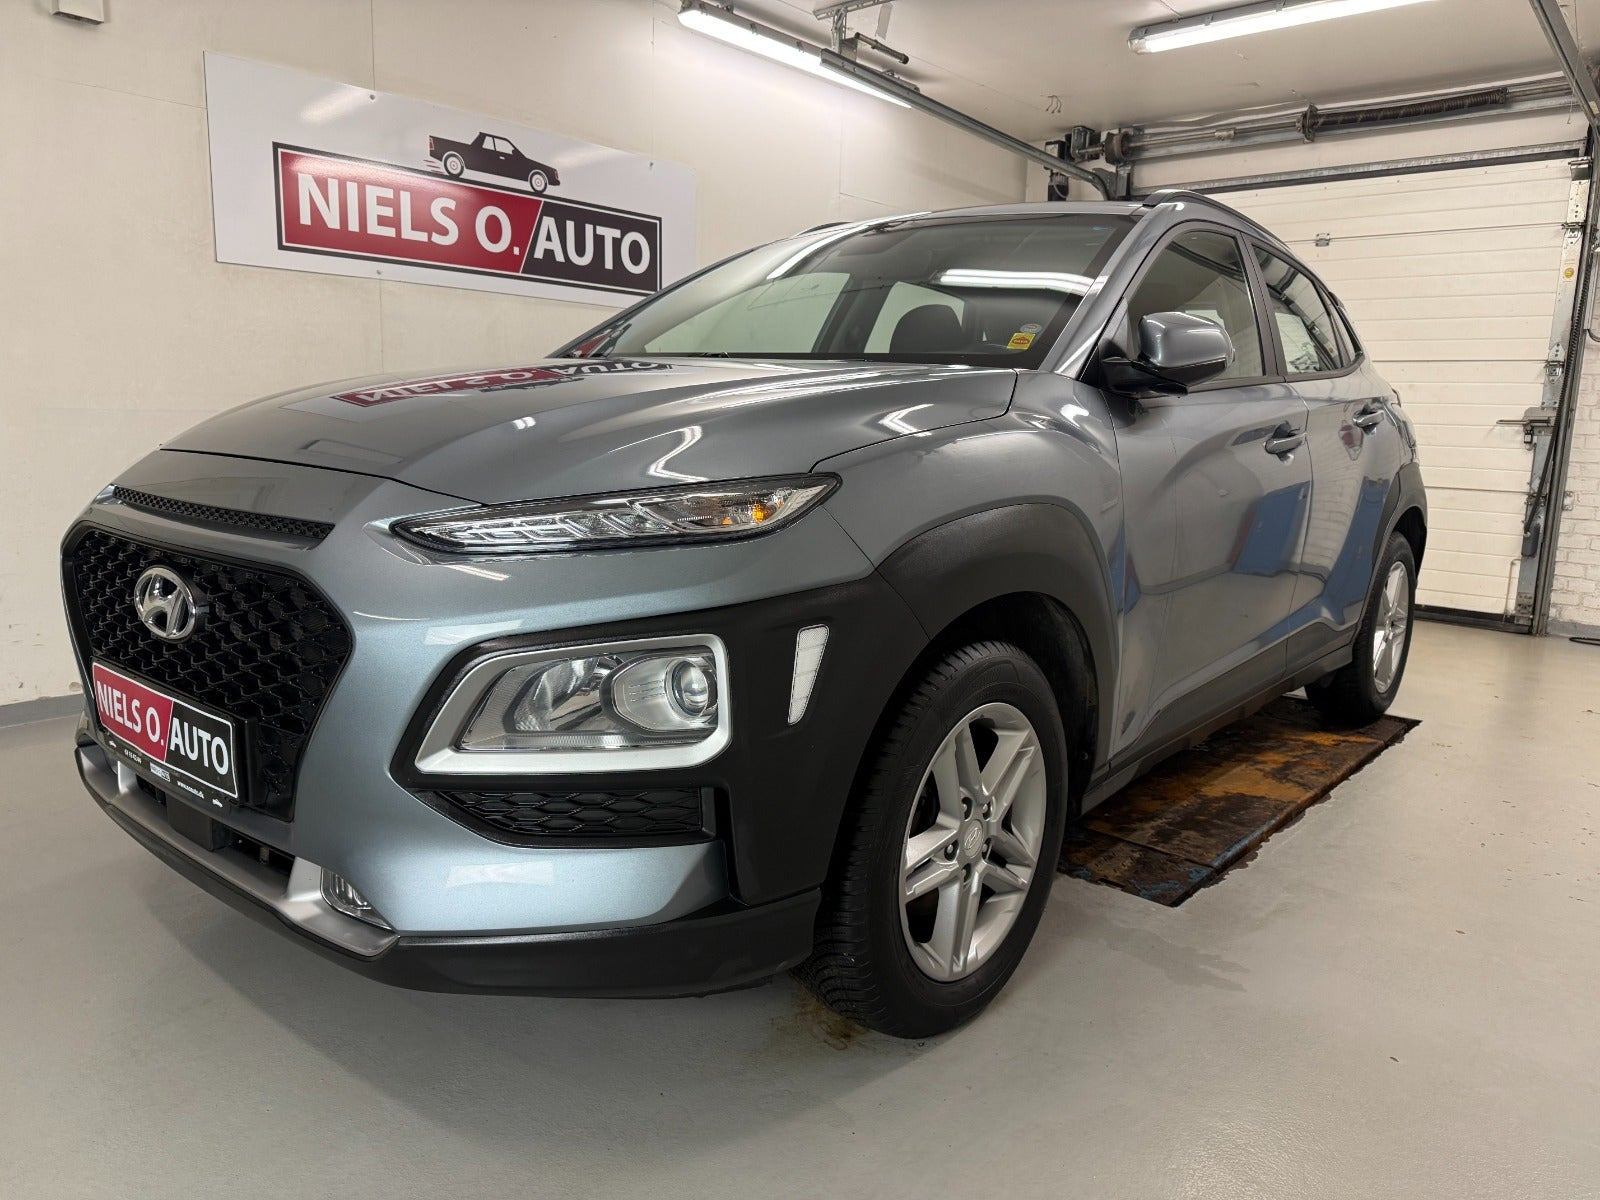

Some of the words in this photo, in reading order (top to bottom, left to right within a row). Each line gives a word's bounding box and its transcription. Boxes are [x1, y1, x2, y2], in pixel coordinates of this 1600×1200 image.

[297, 172, 460, 247] NIELS
[474, 204, 521, 256] O.
[533, 215, 651, 275] AUTO
[96, 680, 142, 734] NIELS
[145, 706, 165, 746] O.
[169, 717, 229, 775] AUTO
